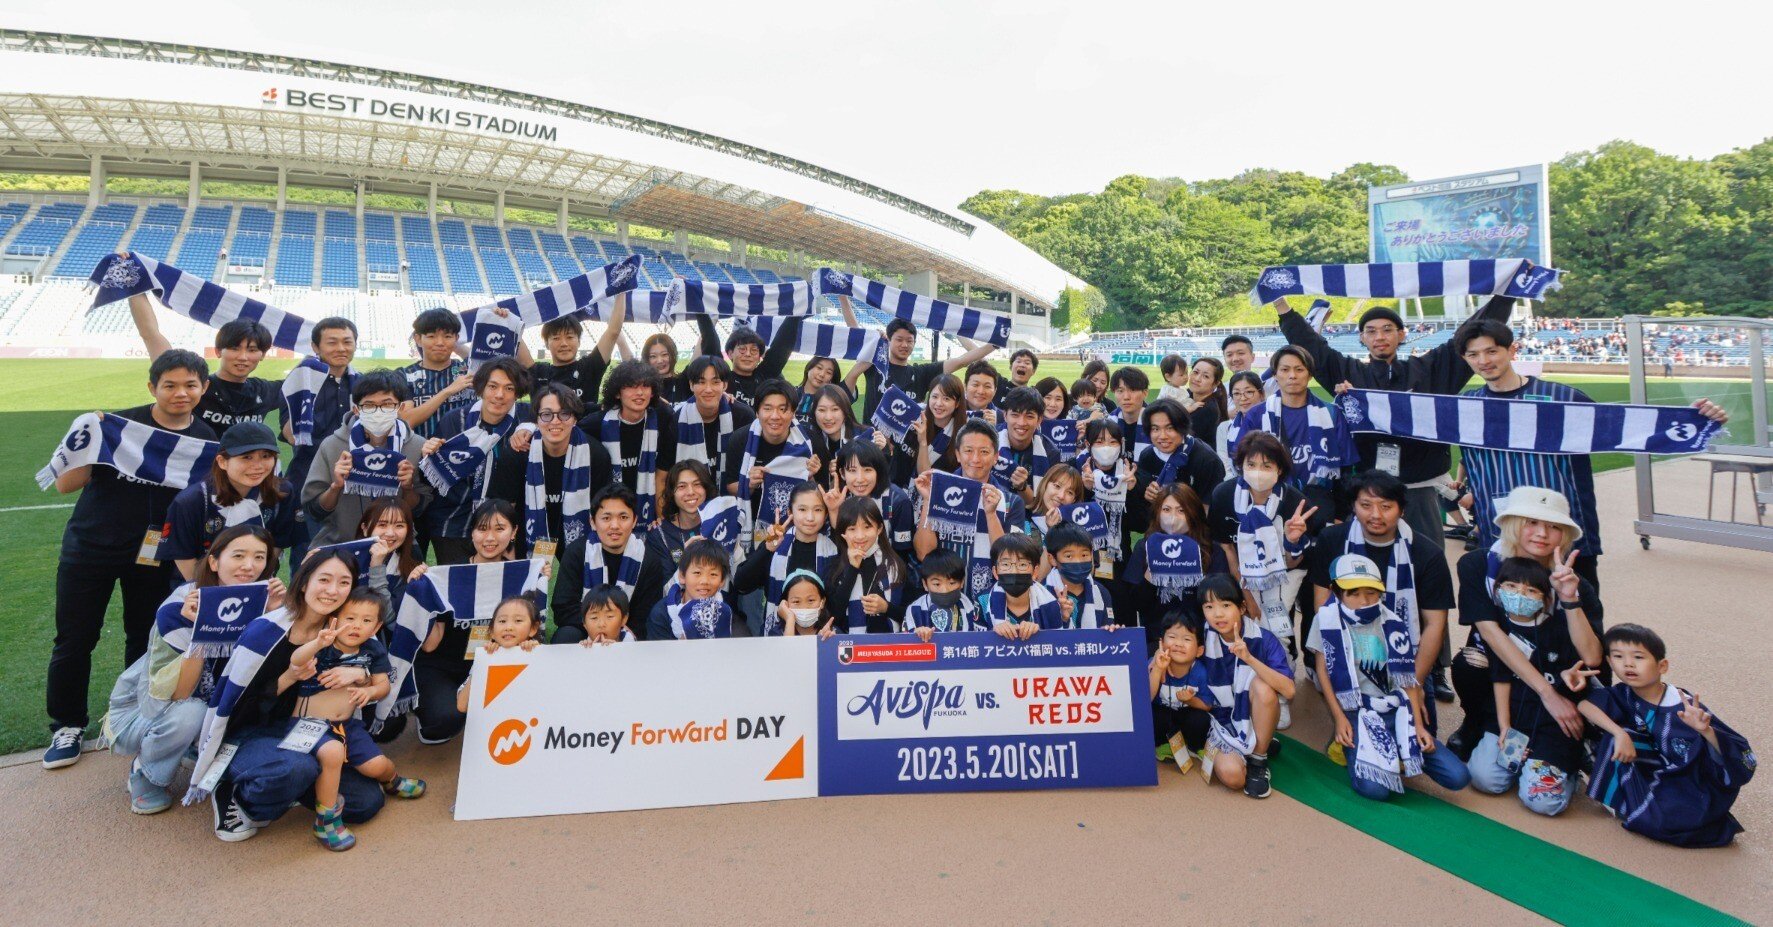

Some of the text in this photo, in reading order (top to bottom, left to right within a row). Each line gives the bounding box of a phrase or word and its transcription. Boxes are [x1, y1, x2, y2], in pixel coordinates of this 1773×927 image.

[286, 89, 365, 113] BEST
[454, 110, 557, 142] STADIUM
[932, 504, 950, 514] Money
[1152, 559, 1172, 568] Money
[200, 624, 226, 635] Money
[942, 645, 980, 659] 第14節
[984, 644, 1053, 657] アビスパ福岡
[1074, 641, 1131, 656] 浦和レッズ
[1012, 676, 1113, 699] URAWA
[1028, 702, 1103, 725] REDS
[299, 722, 322, 733] 2023
[544, 715, 785, 754] Money Forward DAY
[897, 740, 1079, 782] 2023.5.20[SAT]
